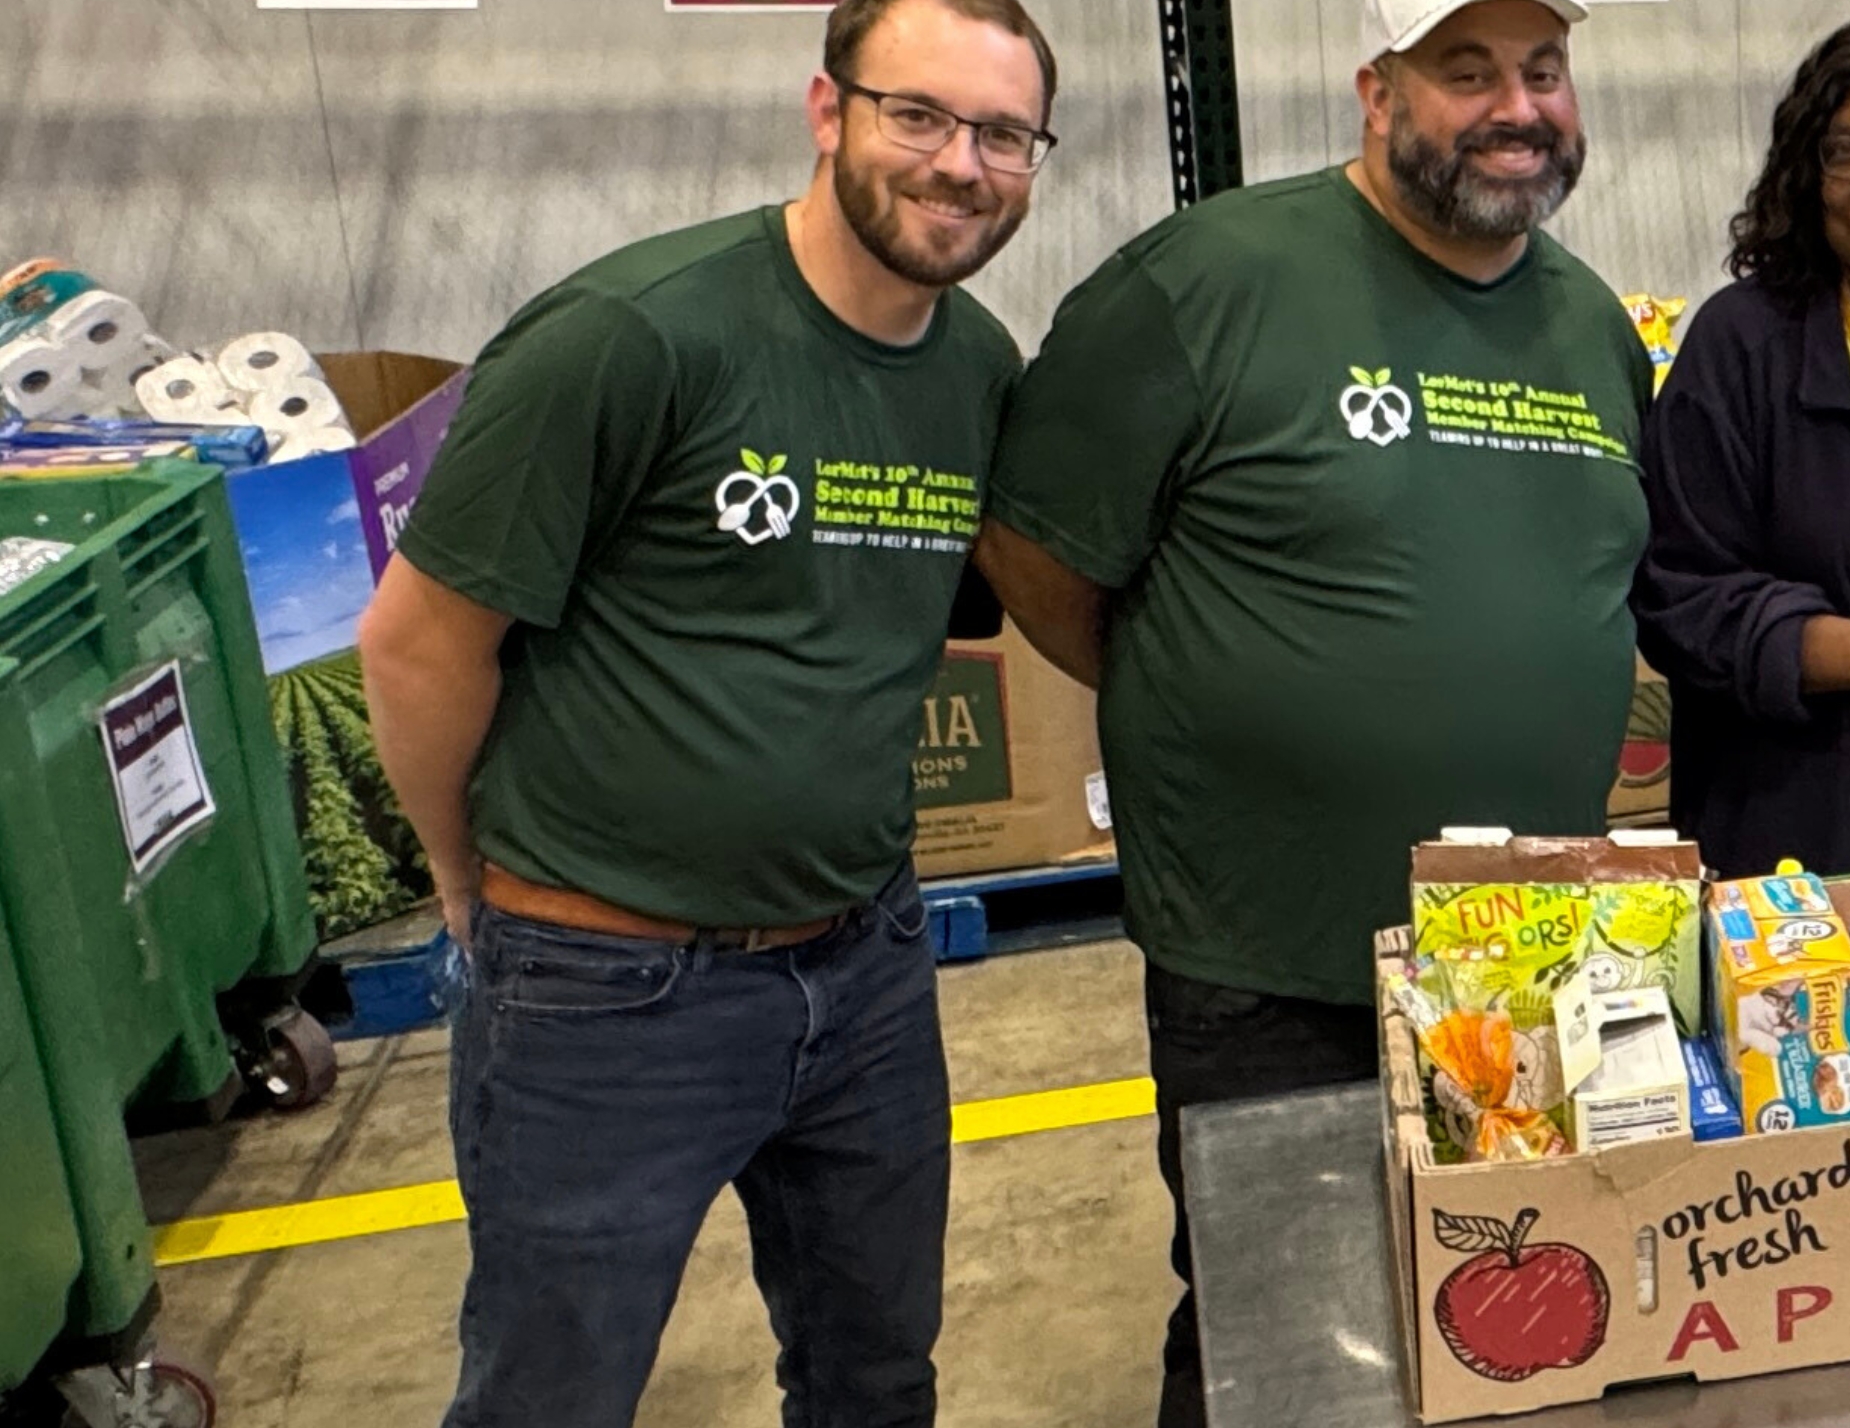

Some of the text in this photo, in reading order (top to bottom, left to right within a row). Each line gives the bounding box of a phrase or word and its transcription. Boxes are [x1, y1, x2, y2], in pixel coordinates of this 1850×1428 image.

[1422, 389, 1601, 431] Second Harvest
[1526, 385, 1587, 409] Annual
[1426, 411, 1488, 431] Member
[1491, 418, 1565, 440] Matching
[815, 479, 900, 508] Second
[814, 505, 874, 526] Member
[877, 510, 950, 535] Matching
[1457, 887, 1525, 935] FUN
[1687, 1208, 1829, 1291] fresh
